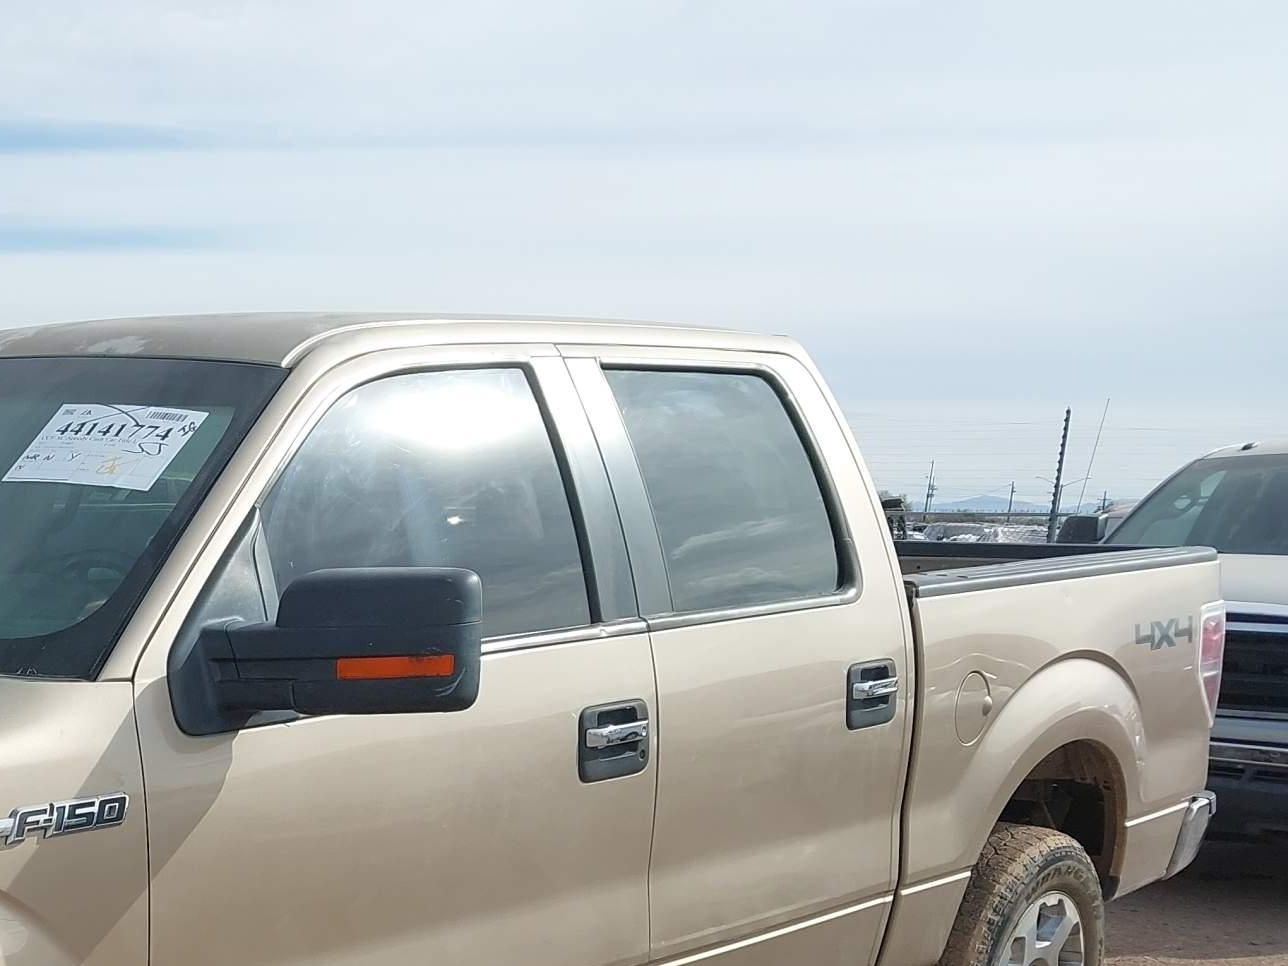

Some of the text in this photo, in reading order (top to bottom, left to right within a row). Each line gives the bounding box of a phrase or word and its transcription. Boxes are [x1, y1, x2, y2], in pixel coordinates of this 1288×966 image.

[55, 421, 174, 441] 44141774
[1134, 615, 1193, 651] 4X4
[5, 793, 130, 846] F-150
